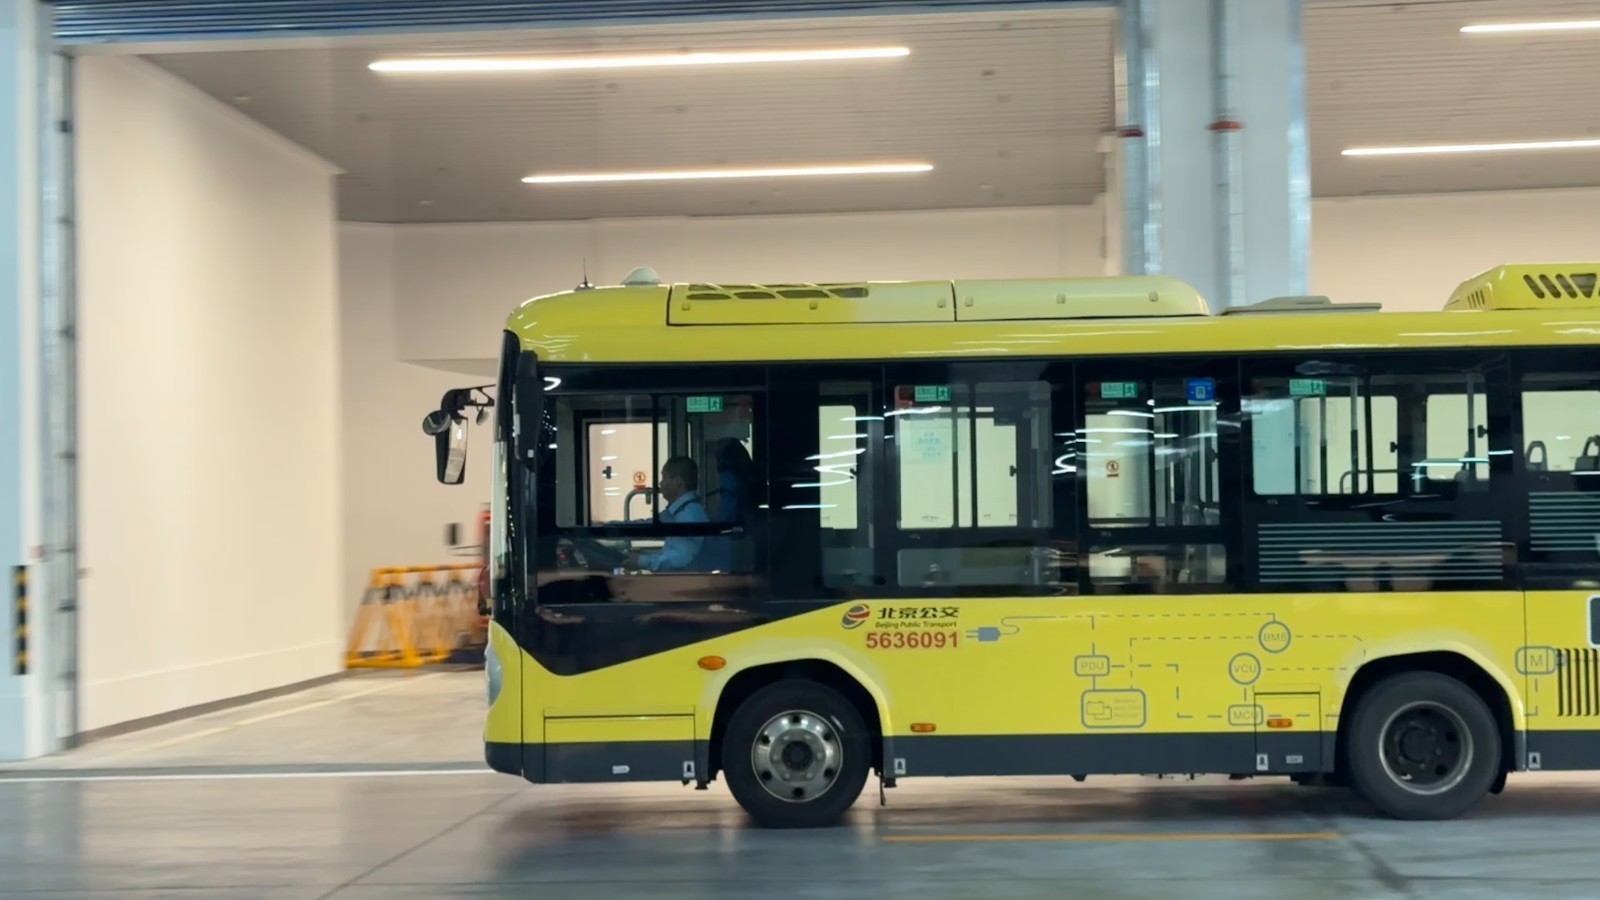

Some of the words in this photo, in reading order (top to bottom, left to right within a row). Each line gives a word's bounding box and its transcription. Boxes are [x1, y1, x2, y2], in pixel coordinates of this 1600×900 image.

[877, 606, 960, 619] 北京公交
[875, 621, 899, 629] Beijing
[923, 621, 957, 629] Transport
[867, 631, 958, 649] 5636091
[1263, 632, 1288, 642] BMS
[1530, 655, 1543, 666] M
[1080, 661, 1104, 671] PDU
[1233, 663, 1257, 673] VCU
